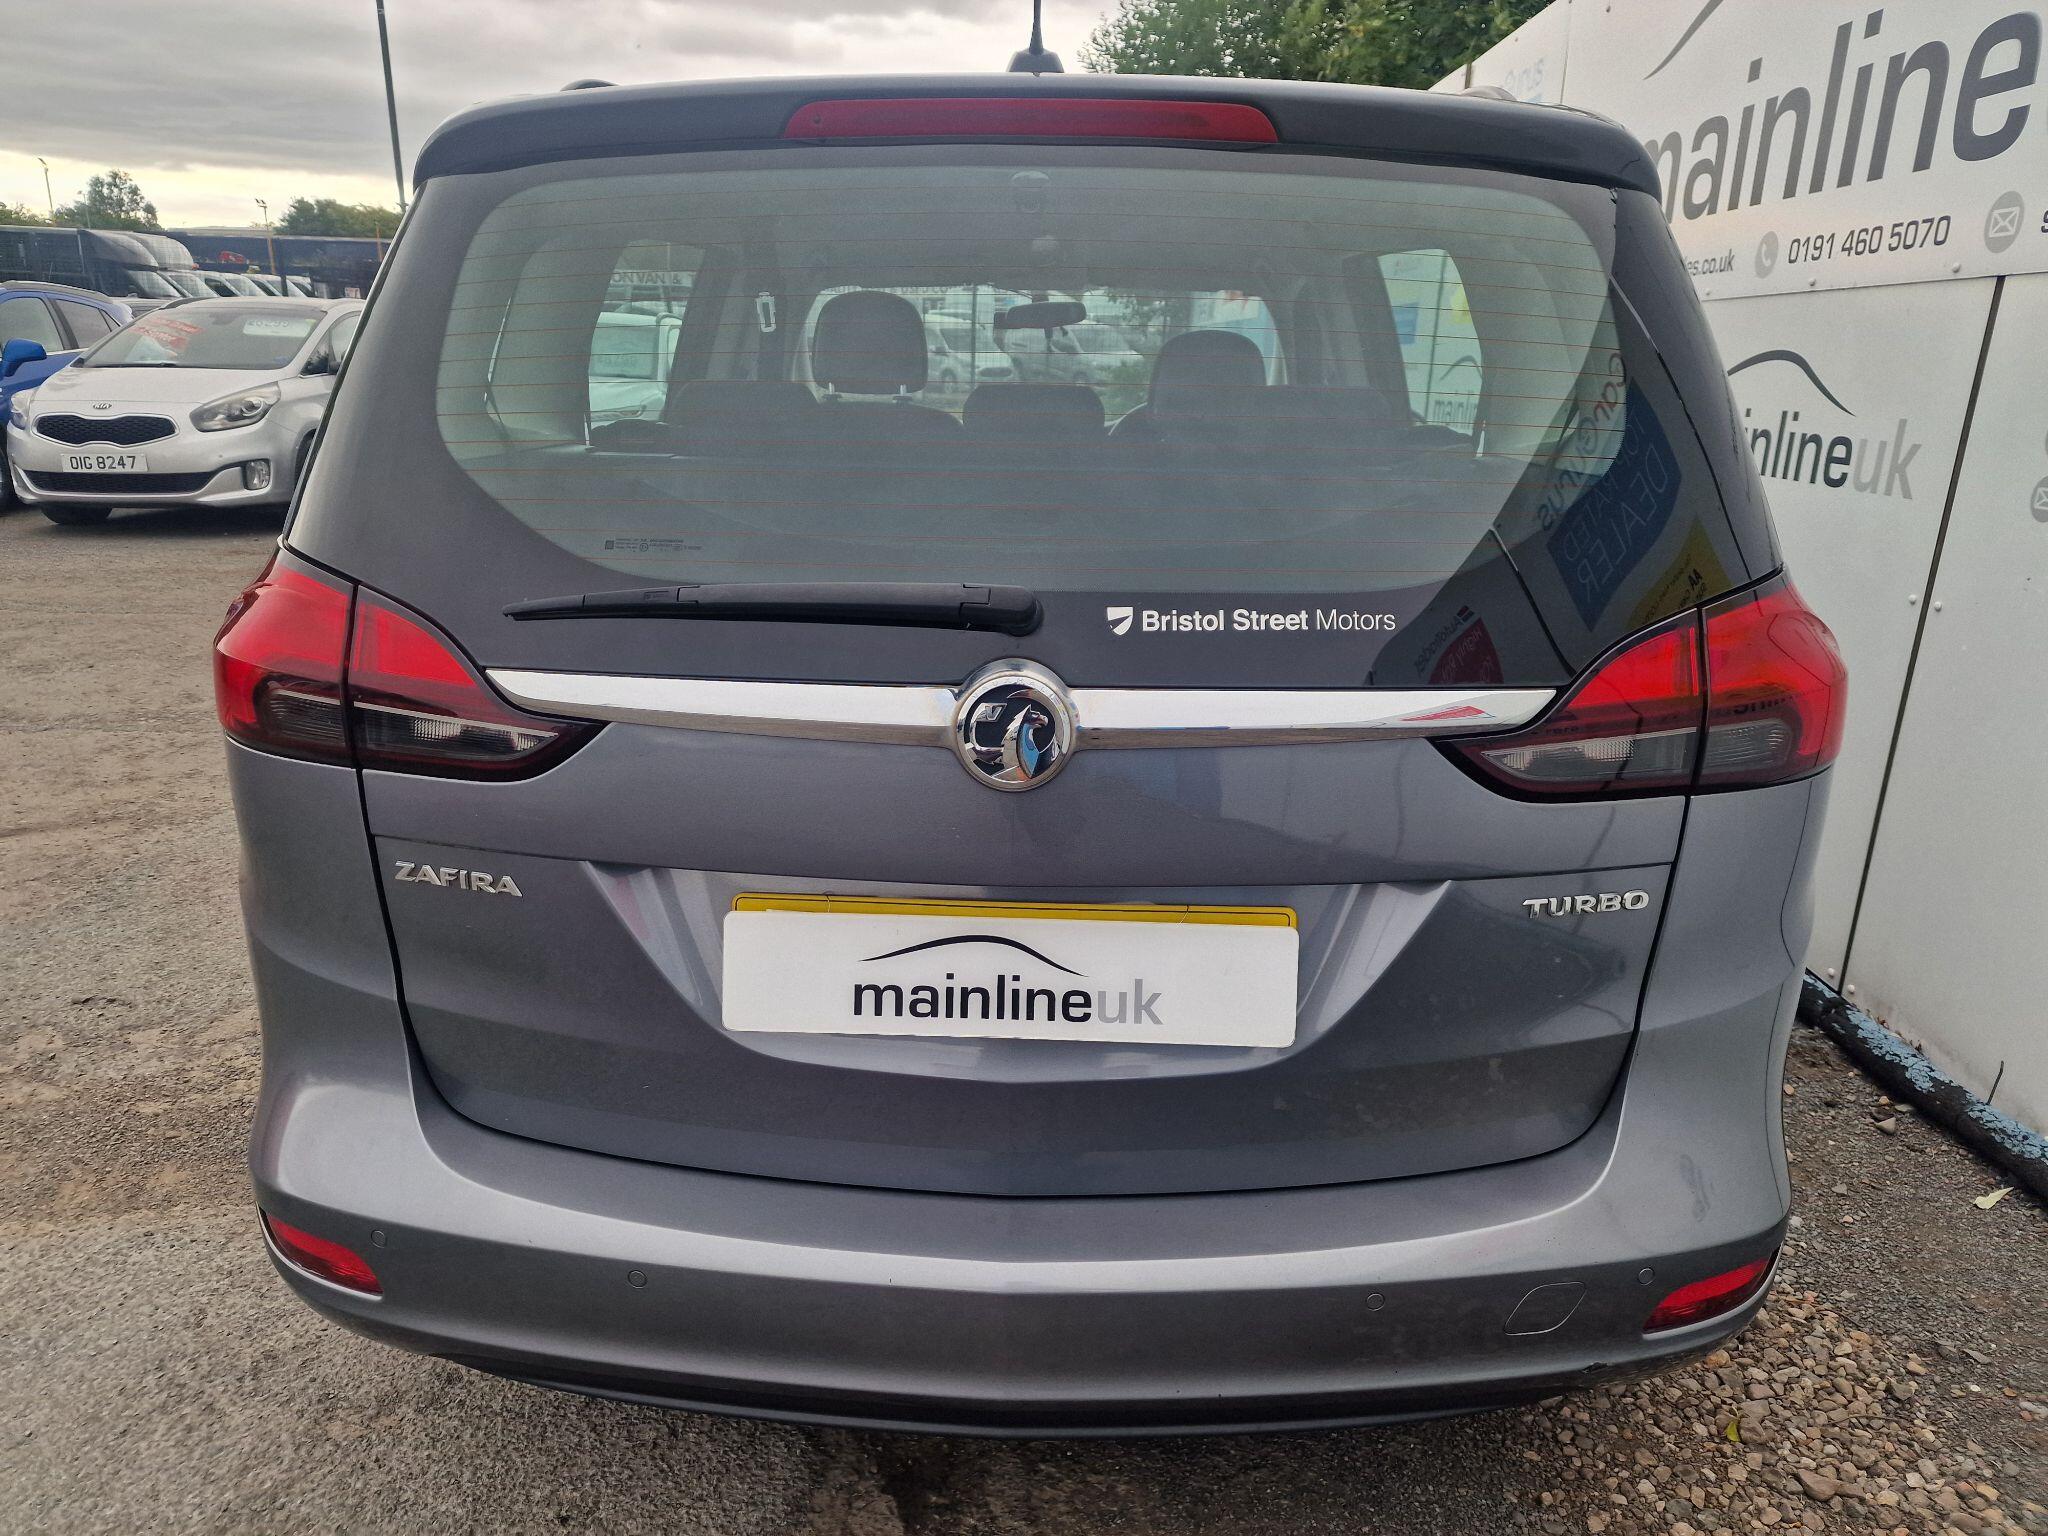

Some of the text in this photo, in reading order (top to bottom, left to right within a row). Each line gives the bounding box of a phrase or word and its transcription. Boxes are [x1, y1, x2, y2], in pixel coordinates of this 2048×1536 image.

[1788, 215, 1951, 265] 0191 460 5070
[1684, 248, 1735, 276] es.co.uk
[97, 456, 136, 469] 8247
[1142, 609, 1396, 631] Bristol Street Motors
[395, 860, 522, 897] ZAFIRA
[1523, 889, 1649, 919] TURBO
[853, 973, 1164, 1025] mainlineuk
